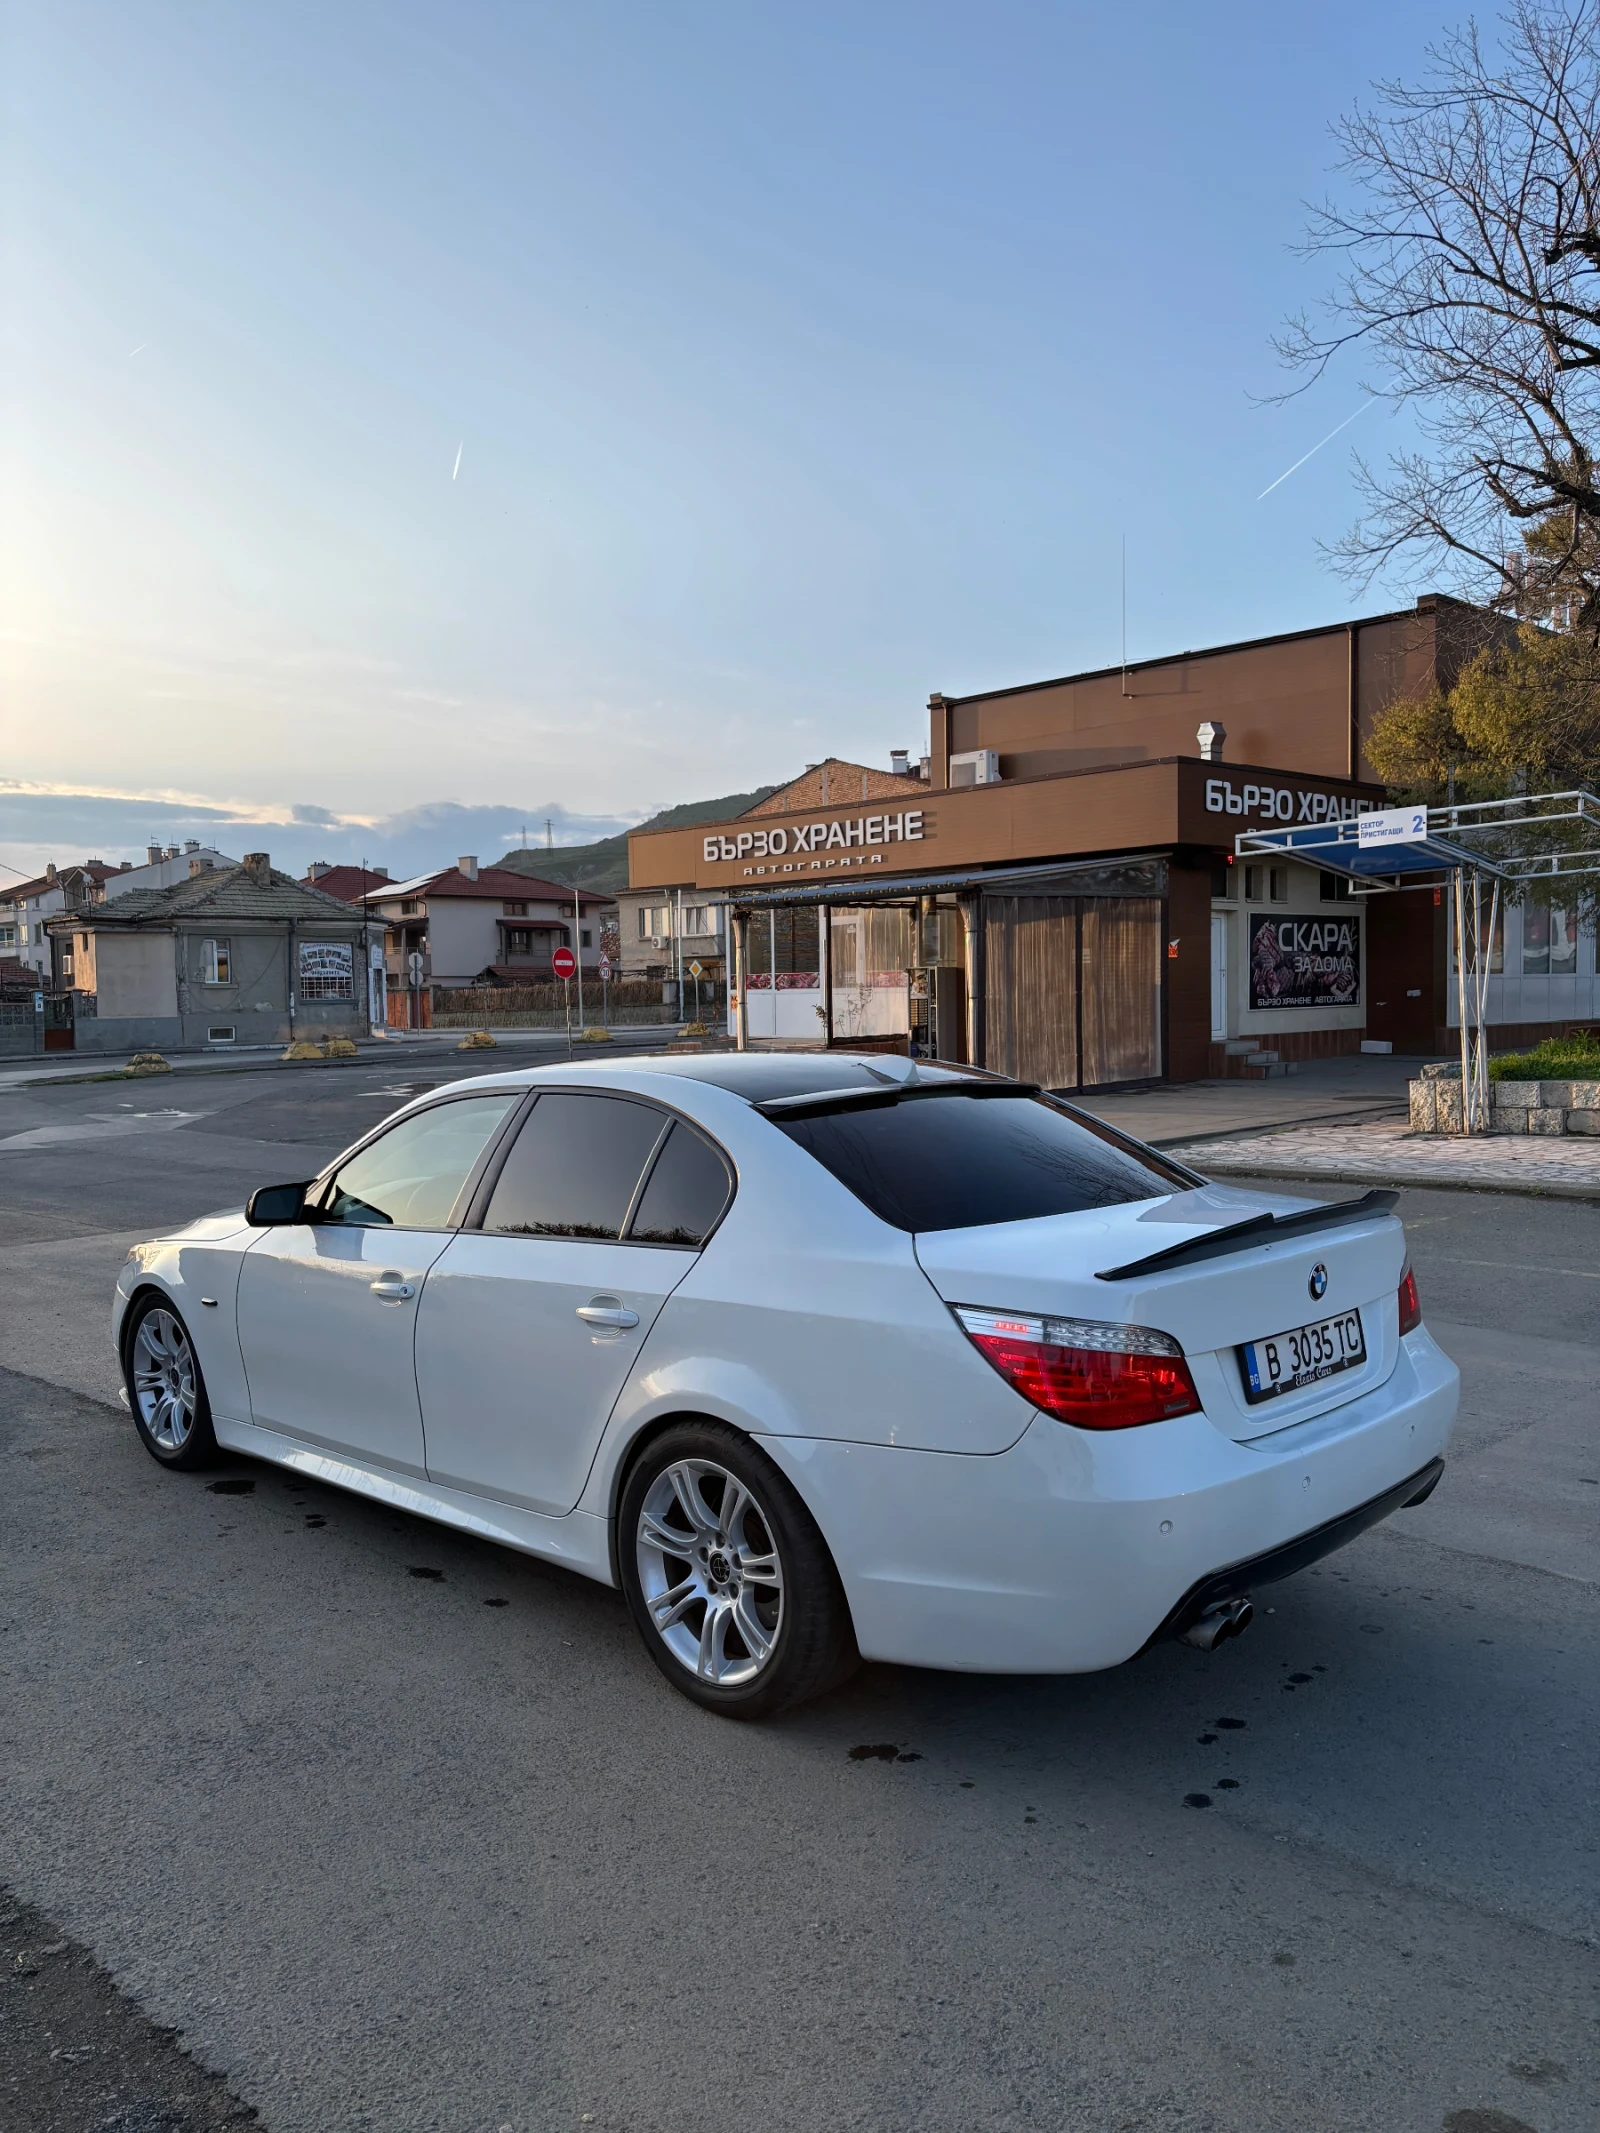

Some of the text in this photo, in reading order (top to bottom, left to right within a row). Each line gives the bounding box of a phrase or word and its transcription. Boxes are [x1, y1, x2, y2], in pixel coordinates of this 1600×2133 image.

[1205, 779, 1293, 821] БЪРЗО
[1360, 820, 1384, 829] СЕКТОР
[1360, 827, 1404, 839] ПРИСТИГАЩИ
[1412, 815, 1423, 833] 2
[703, 811, 924, 862] БЪРЗО ХРАНЕНЕ
[743, 854, 883, 876] АВТОГАРАТА
[1278, 923, 1353, 952] СКАРА
[1294, 956, 1353, 973] ЗА ДОМА
[1257, 995, 1353, 1007] БЪРЗО ХРАНЕНЕ АВТОГАРАТА
[1265, 1317, 1359, 1381] B 3035 TC
[1250, 1373, 1260, 1386] BG
